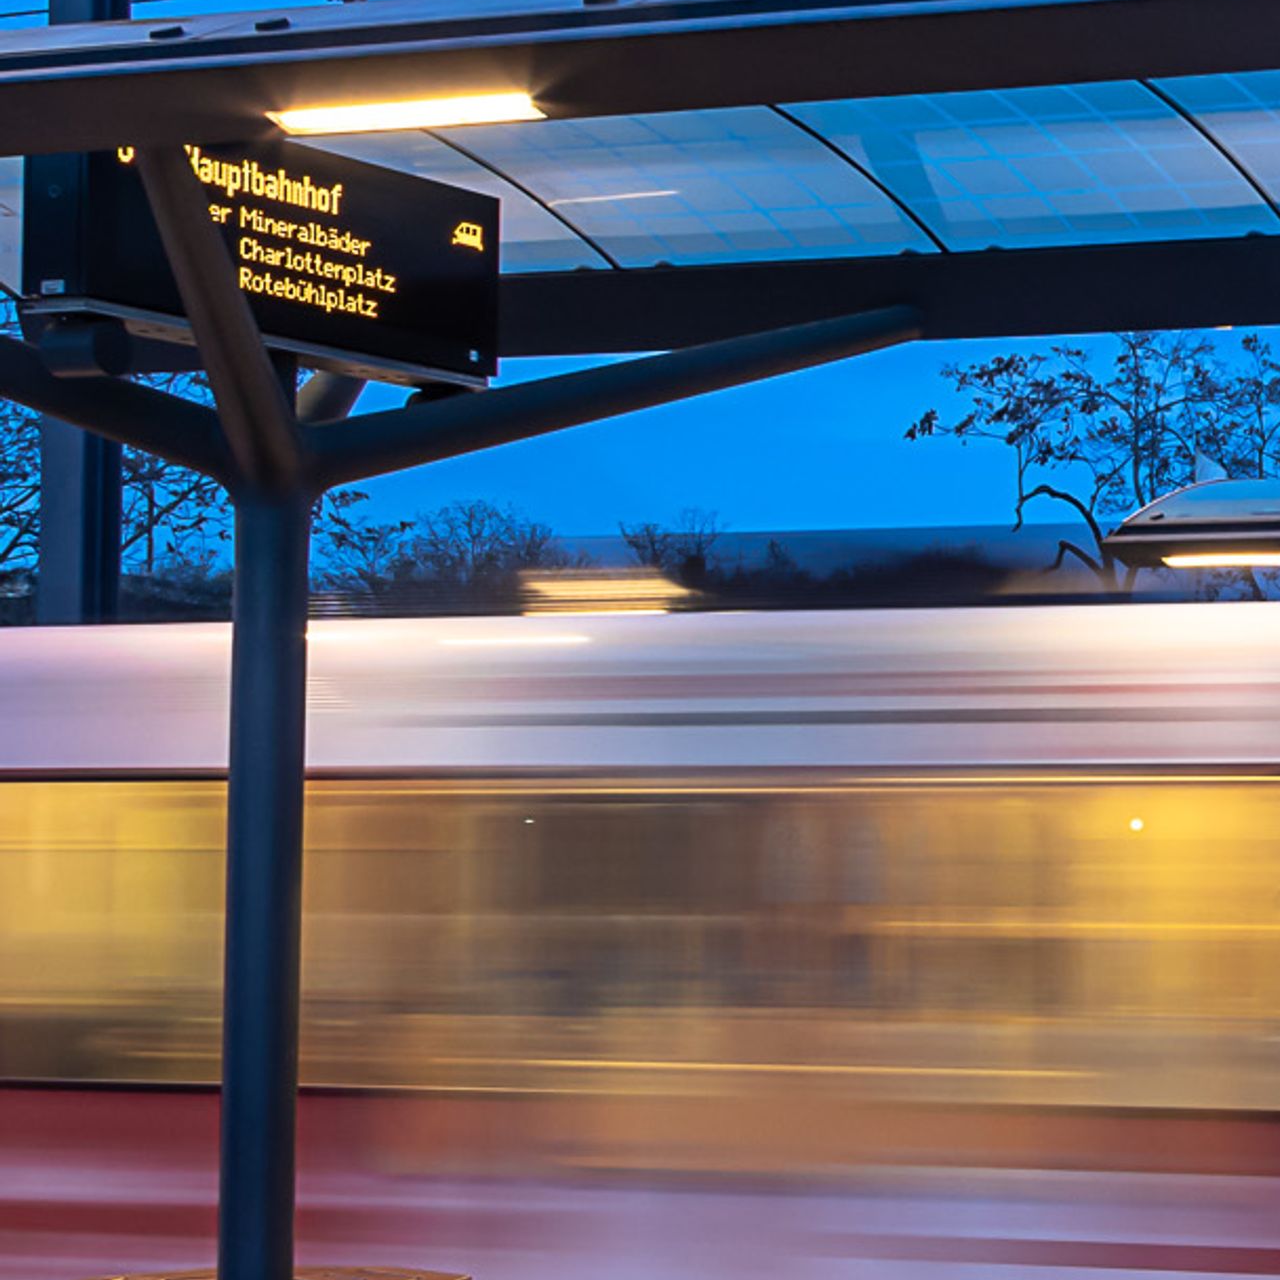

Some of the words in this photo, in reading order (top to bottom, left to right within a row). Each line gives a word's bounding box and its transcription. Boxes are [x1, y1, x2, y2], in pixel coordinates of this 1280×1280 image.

[208, 204, 232, 224] er
[239, 205, 372, 257] Mineralbäder
[239, 237, 396, 293] Charlottenplatz
[239, 267, 378, 318] Rotebühlplatz
